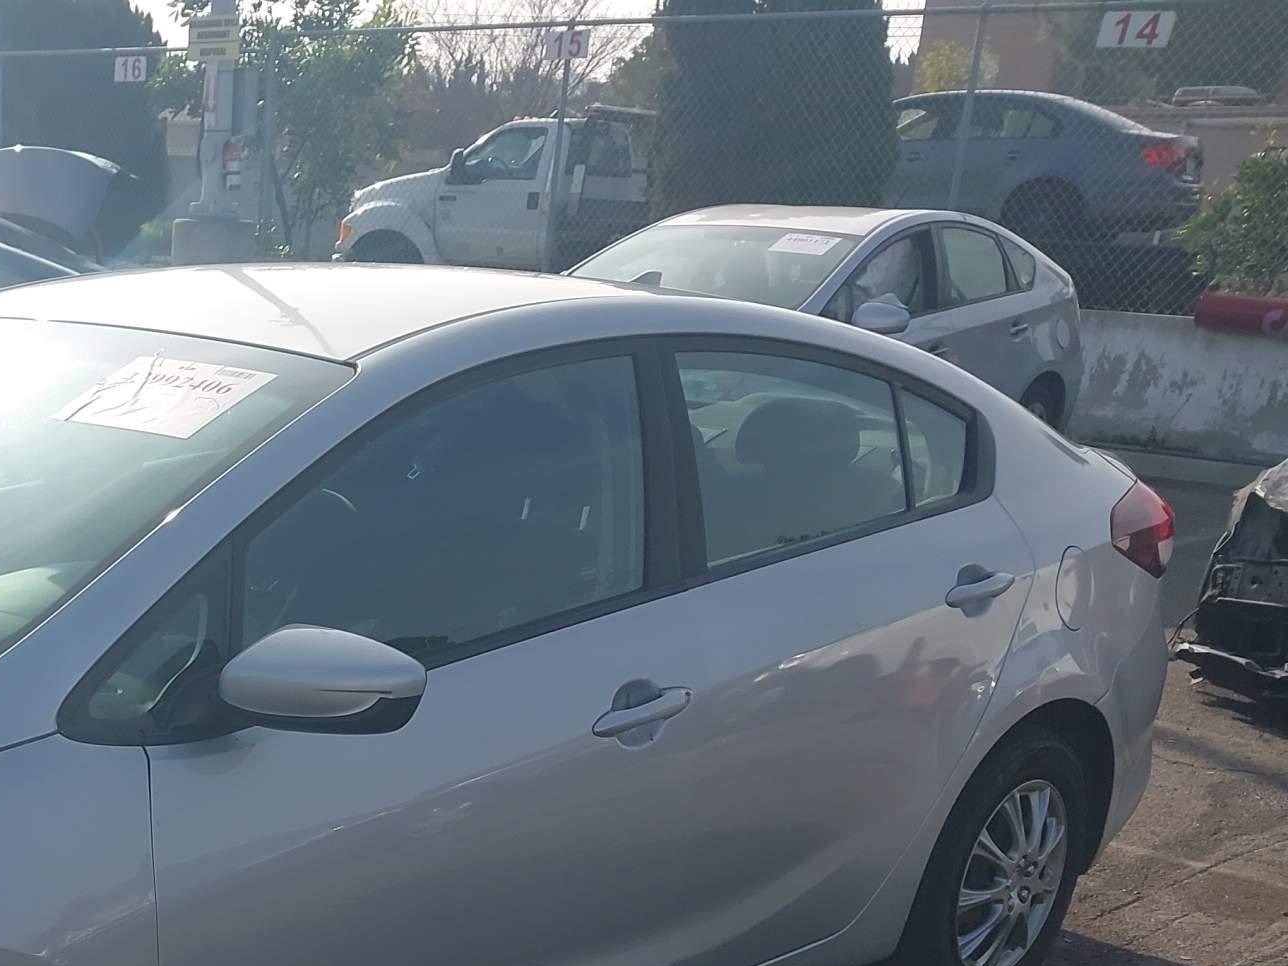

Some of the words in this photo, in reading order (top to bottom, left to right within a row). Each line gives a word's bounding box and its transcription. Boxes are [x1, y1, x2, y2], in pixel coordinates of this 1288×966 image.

[1115, 12, 1161, 45] 14
[554, 31, 583, 57] 15
[121, 58, 142, 80] 16
